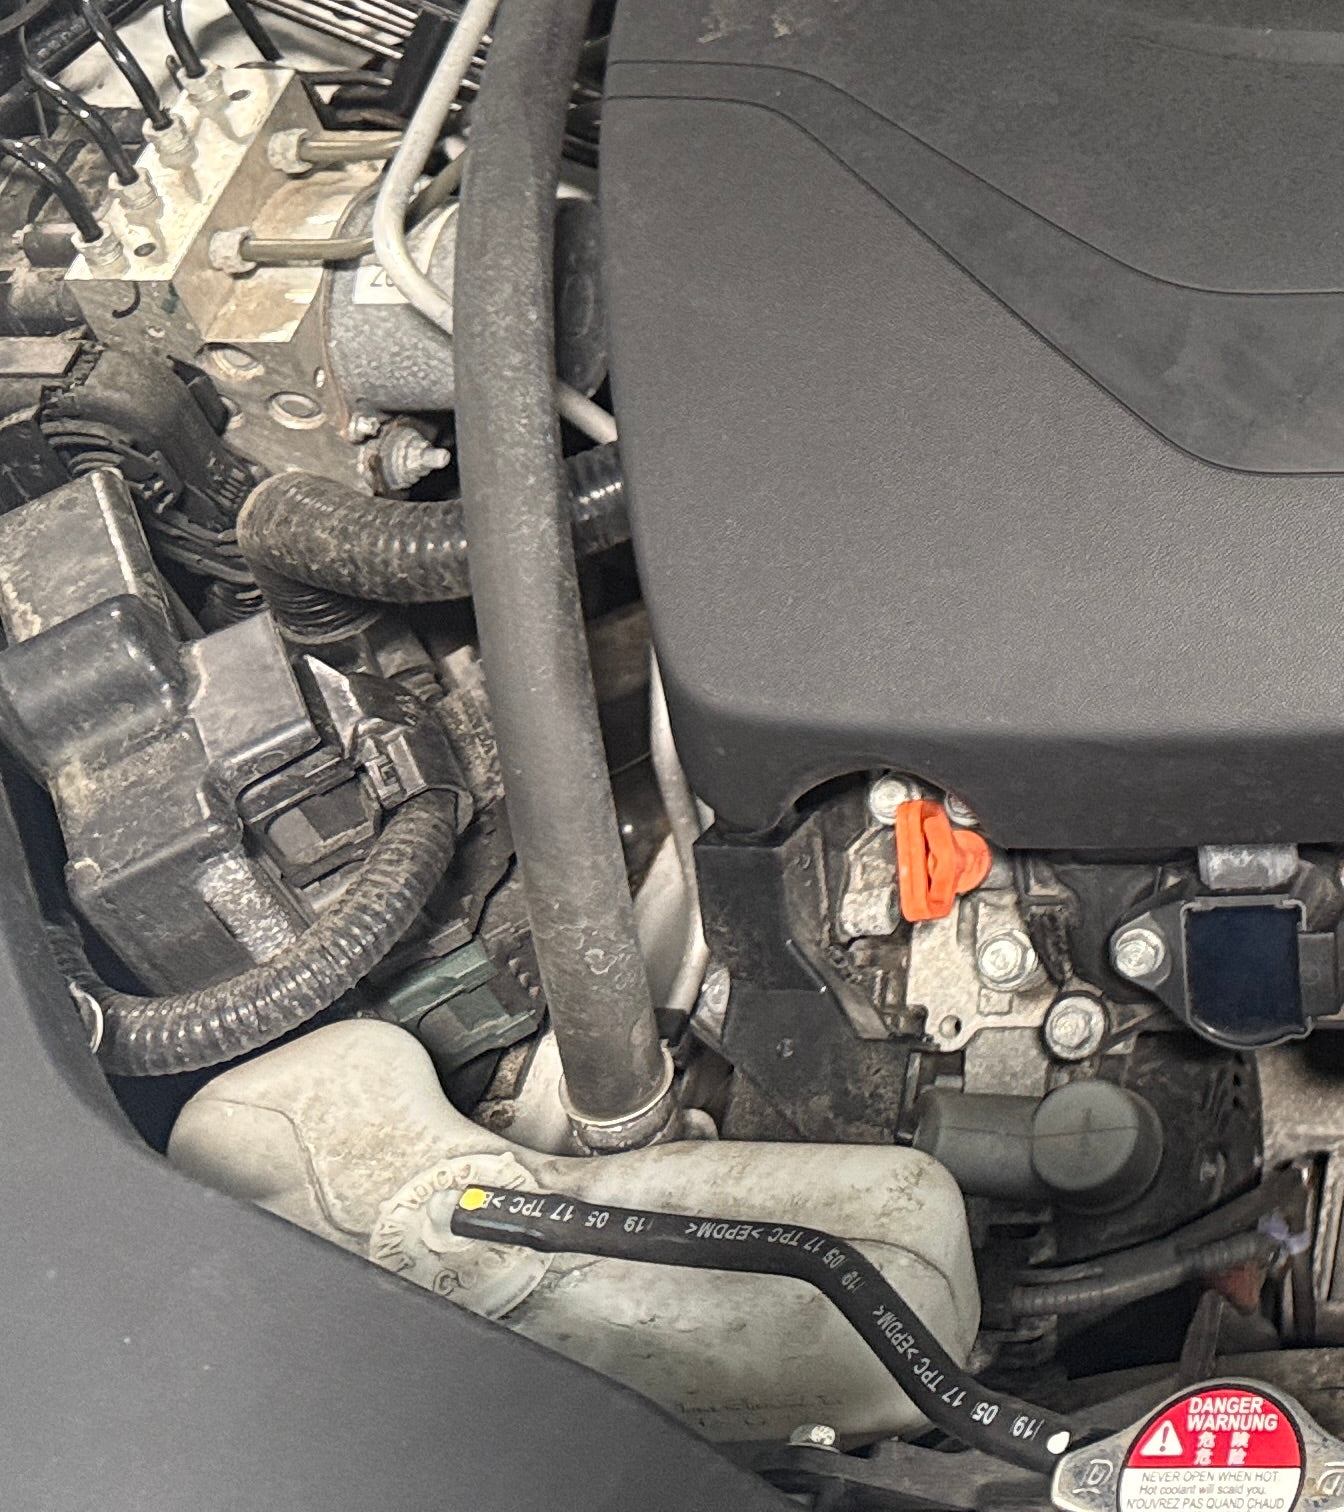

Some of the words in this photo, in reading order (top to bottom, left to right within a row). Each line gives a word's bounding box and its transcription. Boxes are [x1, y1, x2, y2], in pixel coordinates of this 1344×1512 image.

[509, 1197, 547, 1218] TPC
[550, 1203, 575, 1223] 17
[585, 1210, 610, 1229] 05
[624, 1216, 646, 1233] 19
[685, 1221, 765, 1239] >EPDM<
[768, 1227, 804, 1247] TPC
[803, 1236, 825, 1254] 17
[872, 1304, 920, 1361] >EPDM<
[913, 1357, 945, 1393] TPC
[941, 1386, 967, 1407] 17
[1188, 1396, 1265, 1414] DANGER
[971, 1401, 999, 1426] 05
[1186, 1414, 1279, 1432] WARNUNG
[1011, 1414, 1038, 1440] 19
[1142, 1470, 1181, 1482] NEVER
[1183, 1470, 1215, 1482] OPEN
[1218, 1470, 1251, 1482] WHEN
[1139, 1484, 1158, 1495] Hot
[1160, 1484, 1197, 1495] coolant
[1217, 1483, 1244, 1495] scald
[1126, 1497, 1181, 1509] N'OUVREZ
[1183, 1497, 1204, 1509] PAS
[1206, 1497, 1245, 1509] QUAND
[1247, 1497, 1285, 1509] CHAUD
